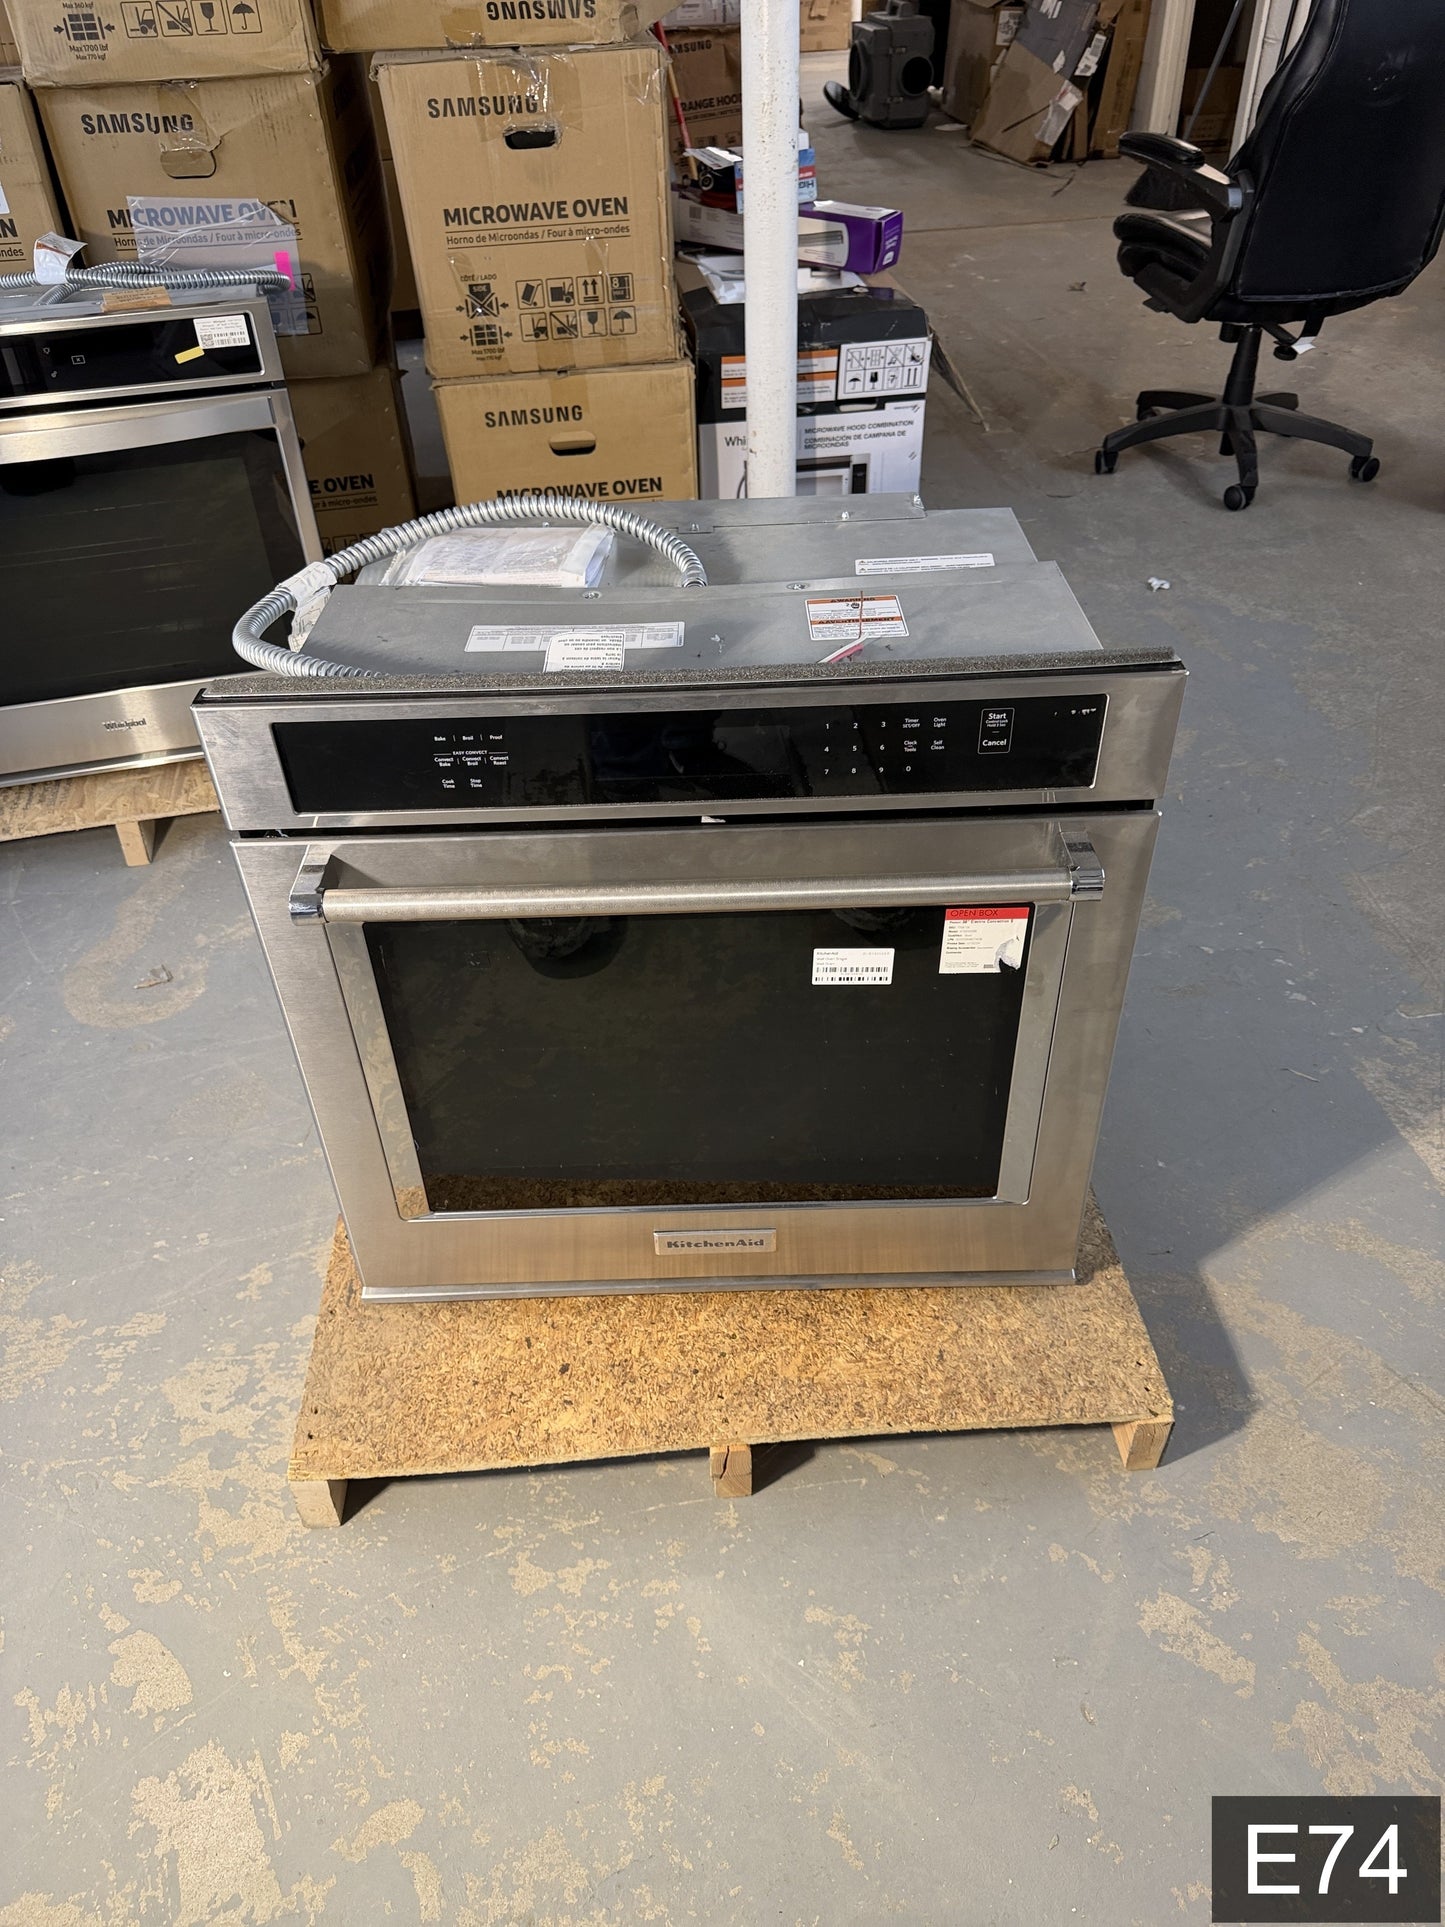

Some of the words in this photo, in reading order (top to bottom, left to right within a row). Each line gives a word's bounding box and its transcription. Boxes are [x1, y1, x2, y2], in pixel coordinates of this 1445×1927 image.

[486, 0, 596, 20] SAMSUNG
[667, 40, 712, 54] AMSUNG
[427, 94, 538, 118] SAMSUNG
[681, 99, 714, 112] RANGE
[716, 93, 742, 107] HOO
[81, 113, 194, 134] SAMSUNG
[107, 204, 234, 229] MICROWAVE
[443, 200, 569, 227] MICROWAVE
[572, 196, 628, 217] OVEN
[216, 230, 234, 242] Four
[446, 235, 474, 245] Horno
[476, 232, 488, 243] de
[488, 230, 540, 242] Microondas
[547, 228, 567, 238] Four
[575, 224, 630, 236] micro-ondes
[612, 277, 620, 289] 8
[484, 405, 584, 428] SAMSUNG
[804, 425, 846, 434] MICROWAVE
[868, 420, 914, 430] COMBINATION
[864, 431, 896, 440] CAMPANA
[804, 441, 850, 450] MICROONDAS
[324, 474, 374, 493] OVEN
[612, 476, 662, 496] OVEN
[982, 738, 1007, 746] Cancel
[666, 1238, 764, 1249] KitchenAid
